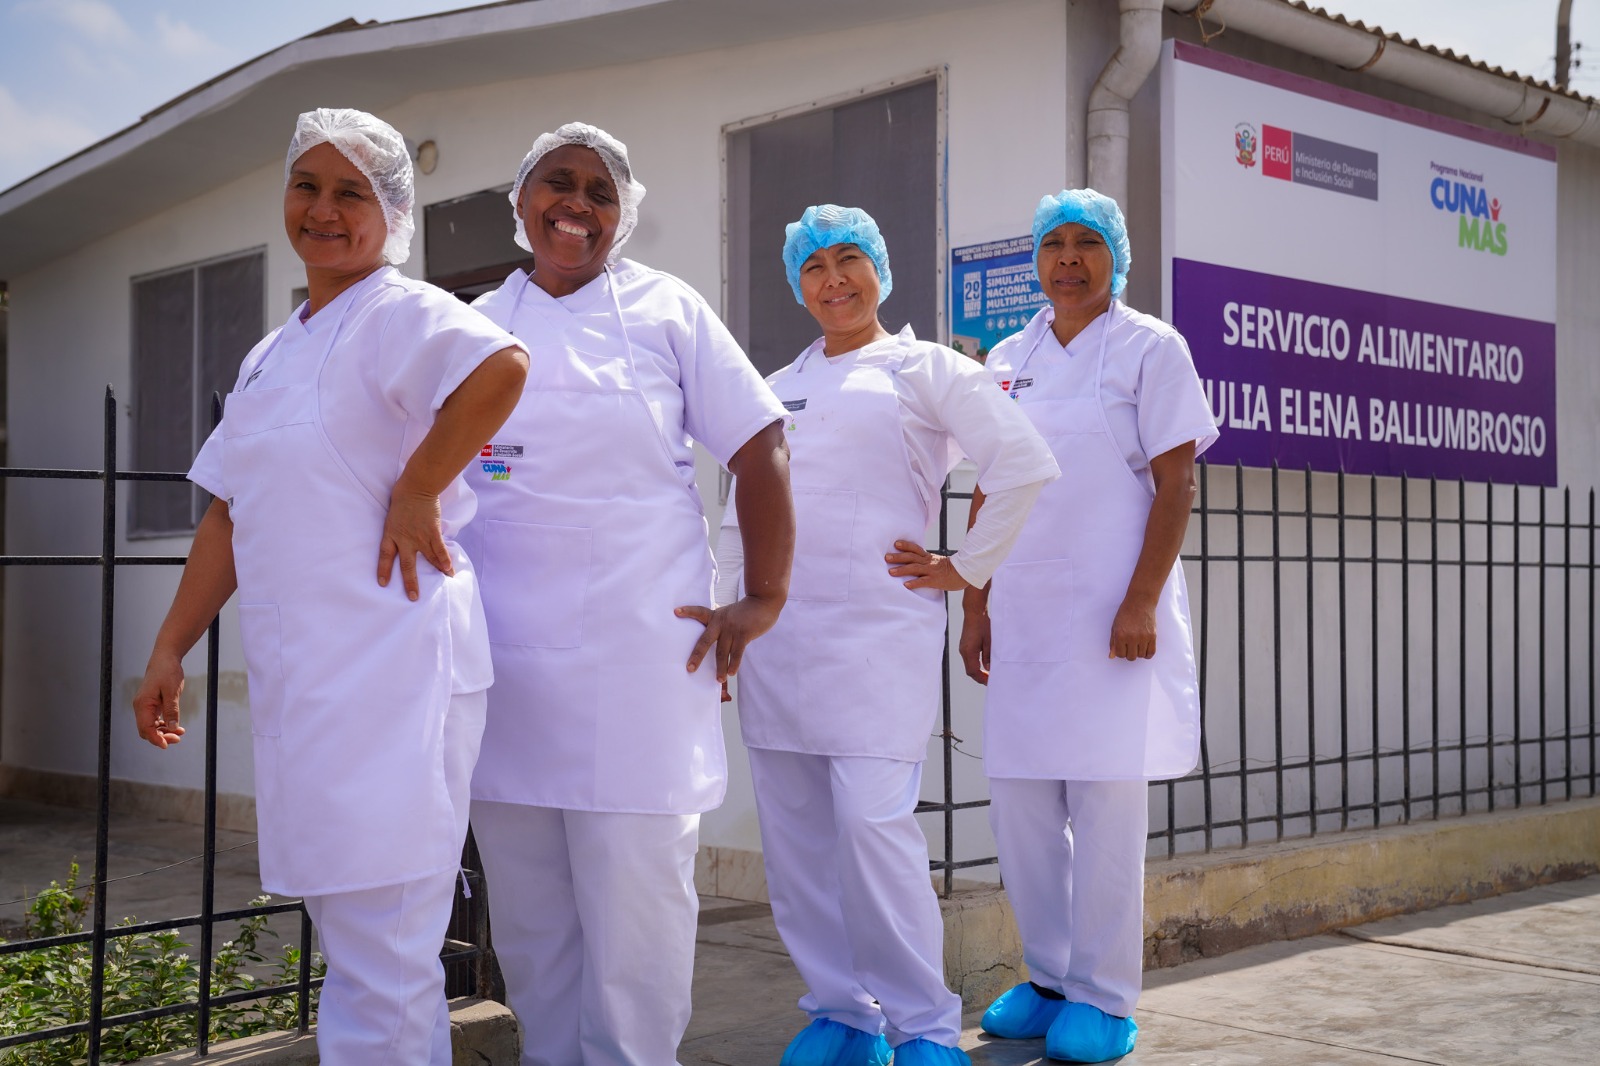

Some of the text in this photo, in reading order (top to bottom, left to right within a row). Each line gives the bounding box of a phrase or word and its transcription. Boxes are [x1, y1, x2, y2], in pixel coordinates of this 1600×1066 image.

[1264, 145, 1290, 164] PERÚ
[1295, 152, 1377, 181] Ministerio de Desarrollo
[1430, 161, 1458, 176] Programa
[1302, 167, 1333, 184] Inclusión
[1333, 175, 1354, 189] Social
[1430, 176, 1490, 220] CUNA
[965, 280, 980, 300] 29
[986, 273, 1037, 288] SIMULACRO
[986, 284, 1031, 298] NACIONAL
[1223, 302, 1524, 384] SERVICIO ALIMENTARIO
[1200, 378, 1546, 457] ULIA ELENA BALLUMBROSIO
